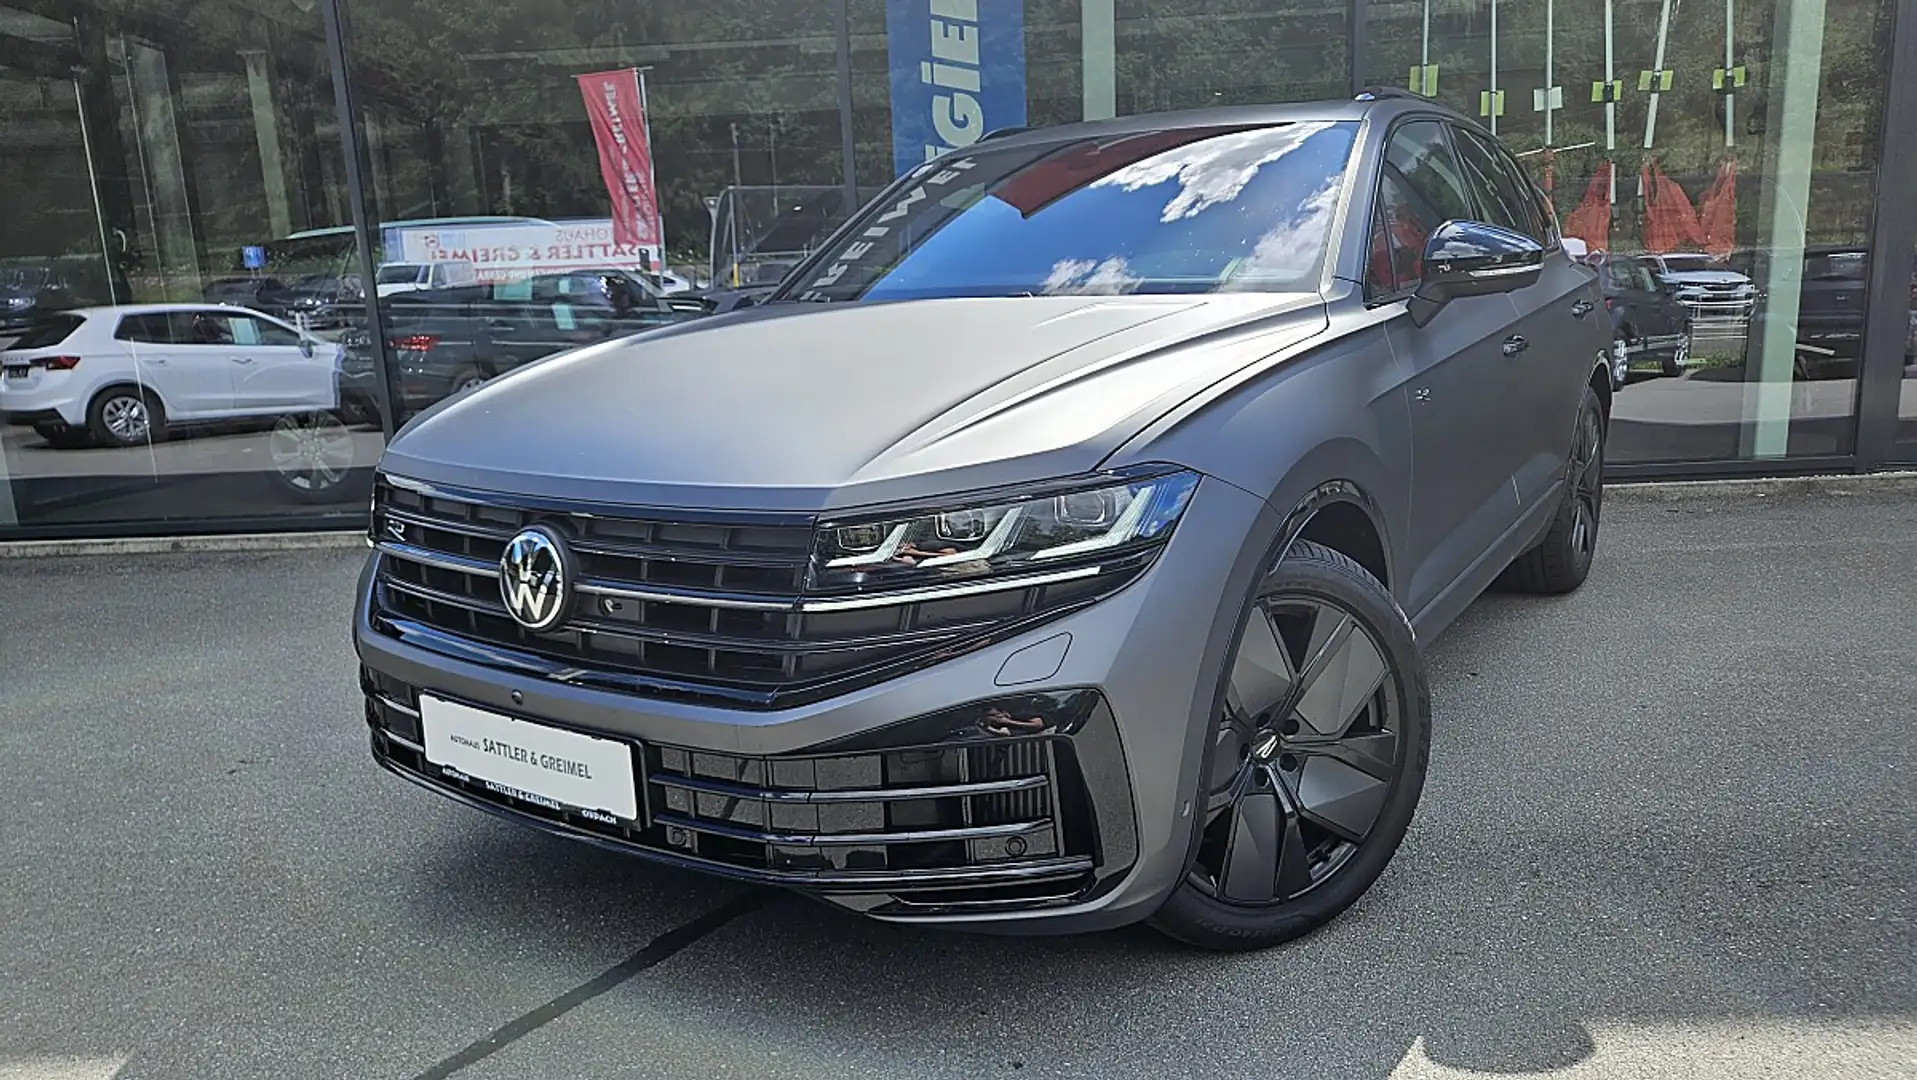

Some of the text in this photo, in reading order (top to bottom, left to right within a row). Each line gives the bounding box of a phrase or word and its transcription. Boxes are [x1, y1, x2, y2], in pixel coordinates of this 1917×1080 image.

[483, 738, 528, 763] SATTLER
[530, 751, 538, 765] &
[540, 754, 593, 779] GREIMEL
